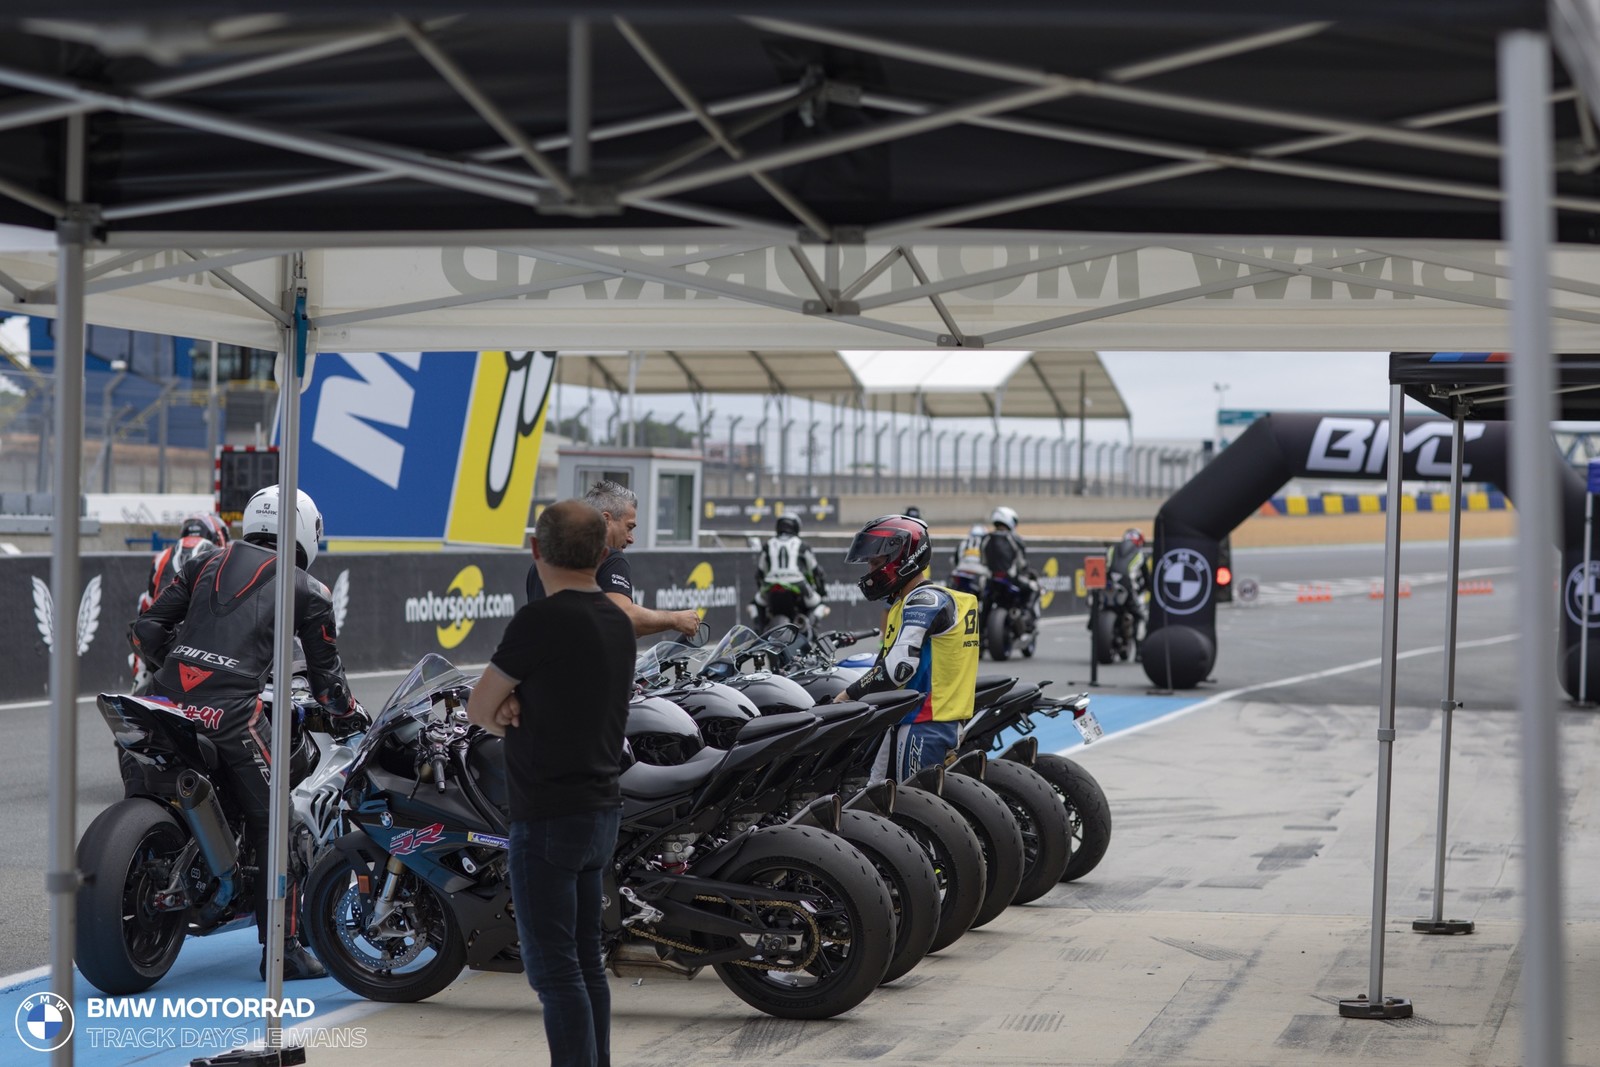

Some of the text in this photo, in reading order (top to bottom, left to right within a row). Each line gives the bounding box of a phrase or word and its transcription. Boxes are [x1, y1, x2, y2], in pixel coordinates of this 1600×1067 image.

[1306, 417, 1485, 477] BMC
[406, 591, 515, 627] motorsport.com
[173, 645, 239, 668] DAINESE
[184, 705, 224, 729] #91
